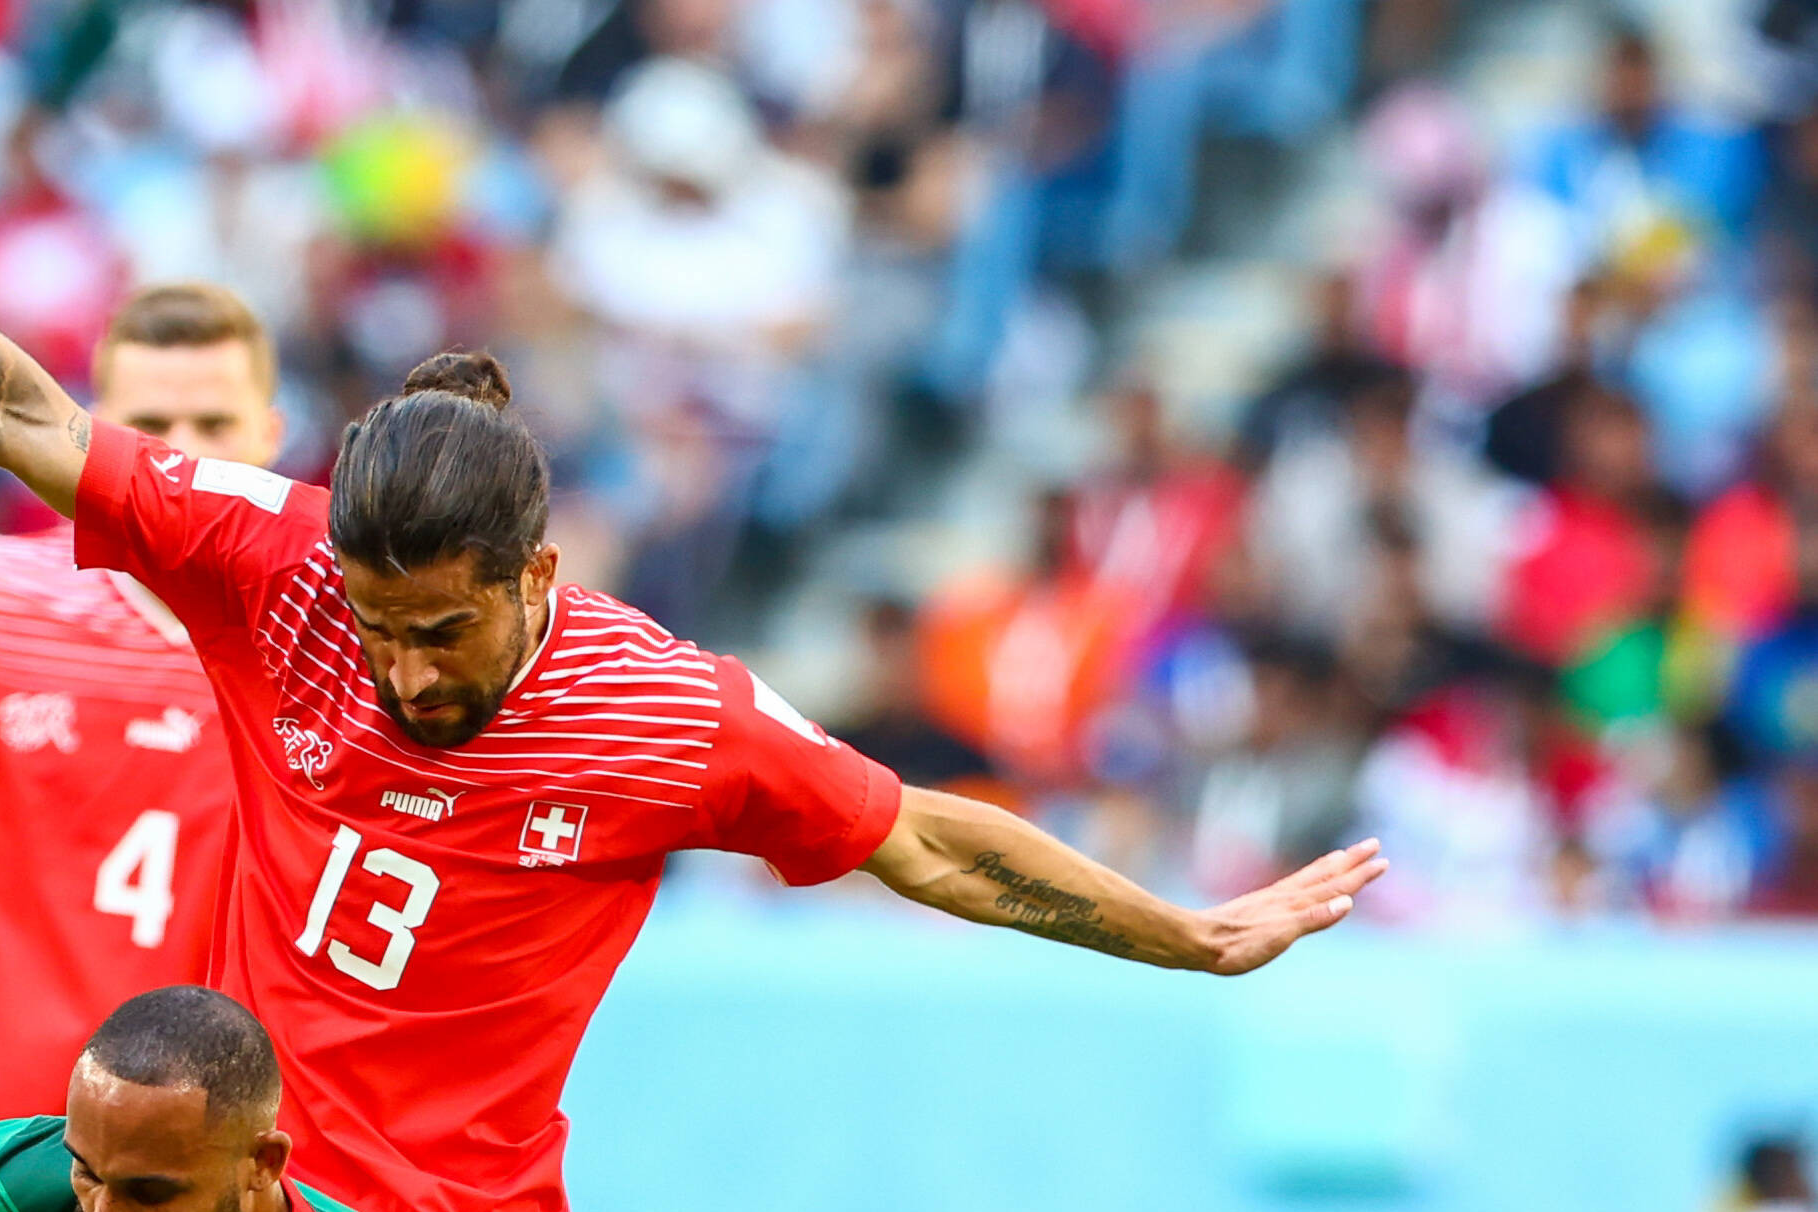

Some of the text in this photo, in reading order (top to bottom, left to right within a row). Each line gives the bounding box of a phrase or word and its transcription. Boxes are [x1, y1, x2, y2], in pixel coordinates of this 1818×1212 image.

[380, 790, 444, 822] PUMA
[93, 809, 180, 949] 4
[294, 823, 441, 991] 13
